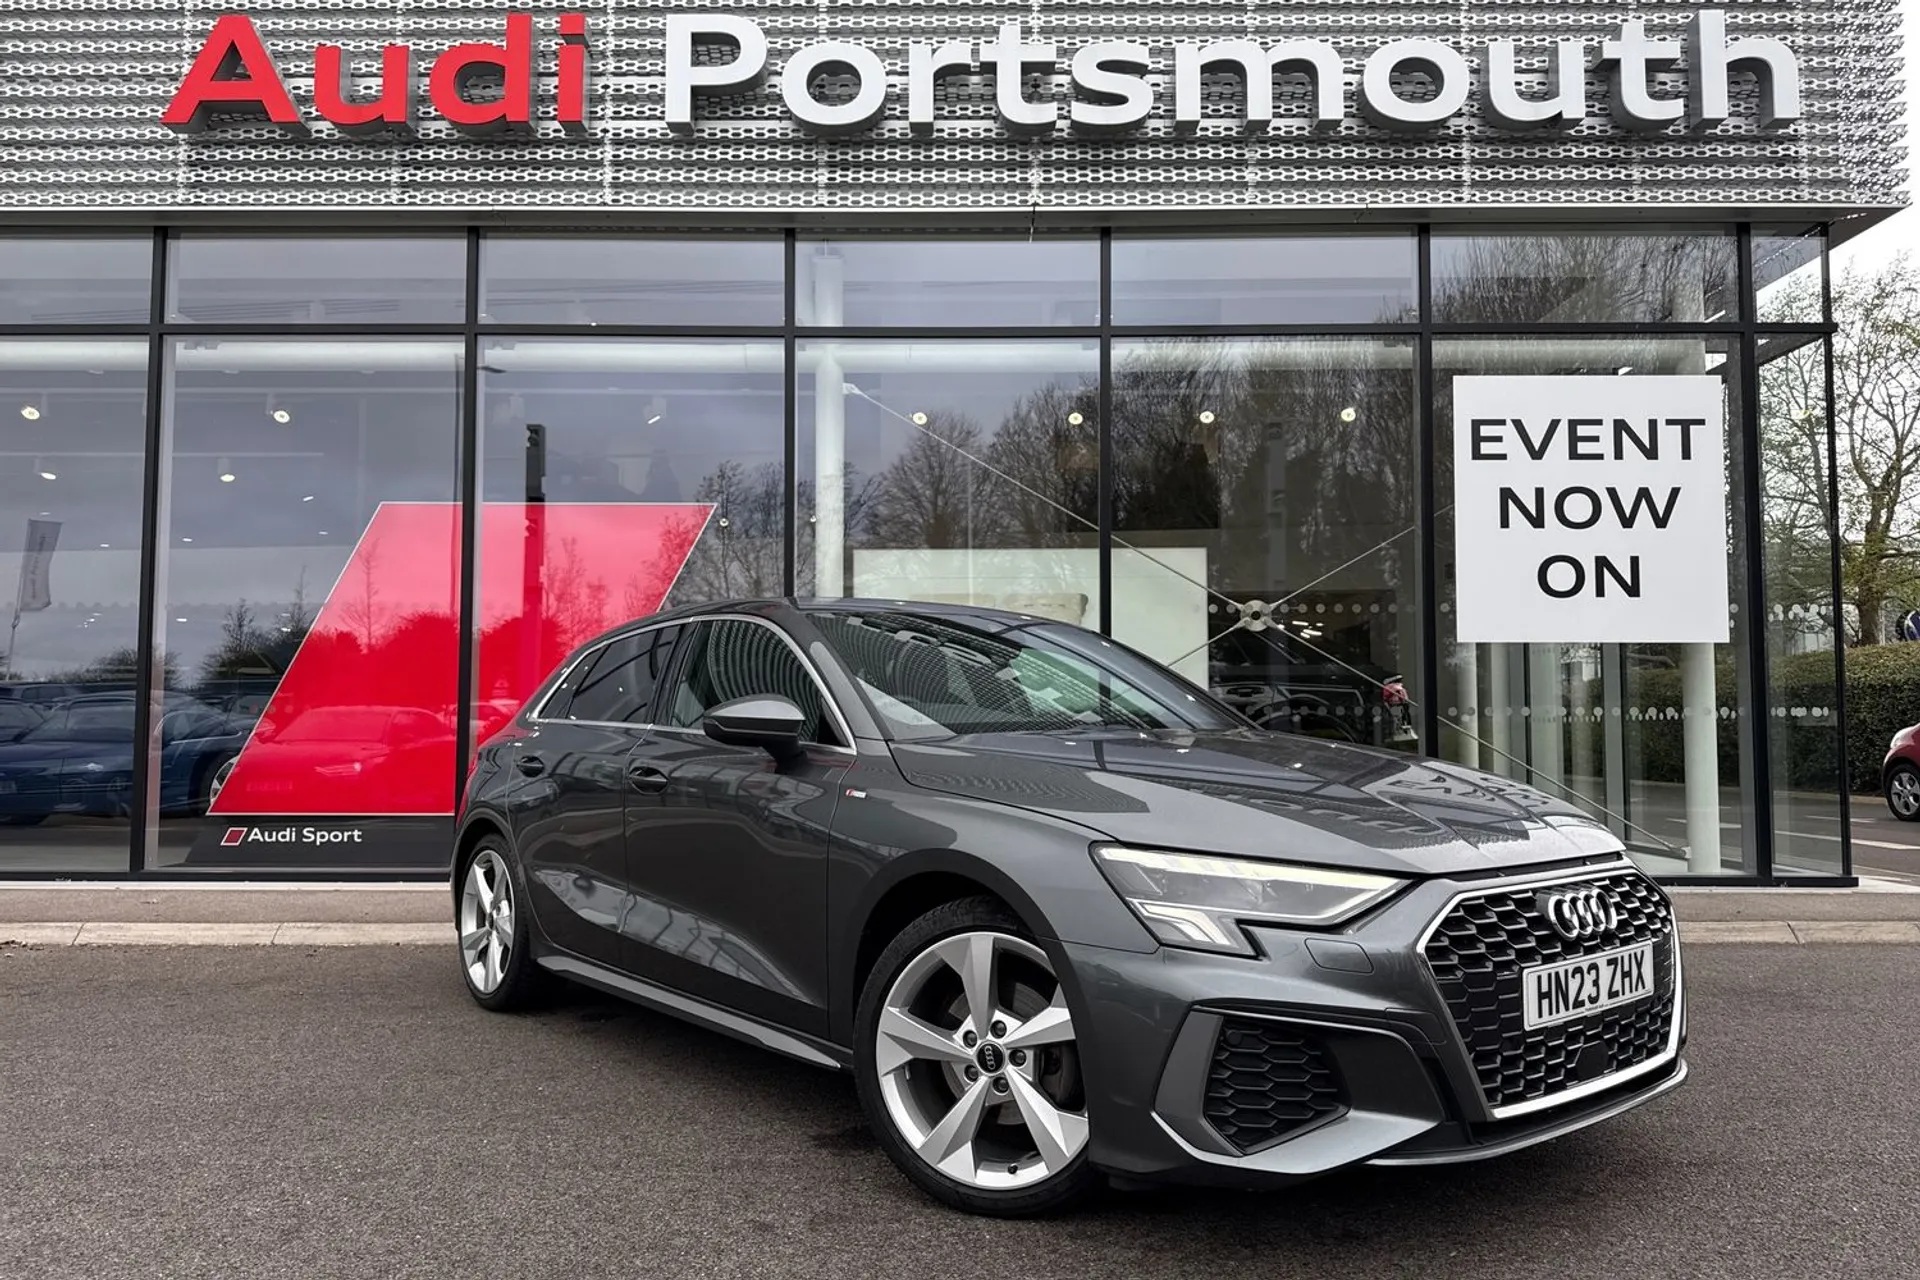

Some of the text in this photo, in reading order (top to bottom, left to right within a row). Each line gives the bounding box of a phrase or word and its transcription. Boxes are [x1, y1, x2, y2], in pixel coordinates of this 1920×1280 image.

[160, 9, 1801, 127] Audi Portsmouth
[1470, 418, 1706, 461] EVENT
[1499, 485, 1681, 530] NOW
[1537, 554, 1641, 598] ON
[247, 827, 362, 846] Audi Sport
[1536, 949, 1646, 1019] HN23 ZHX
